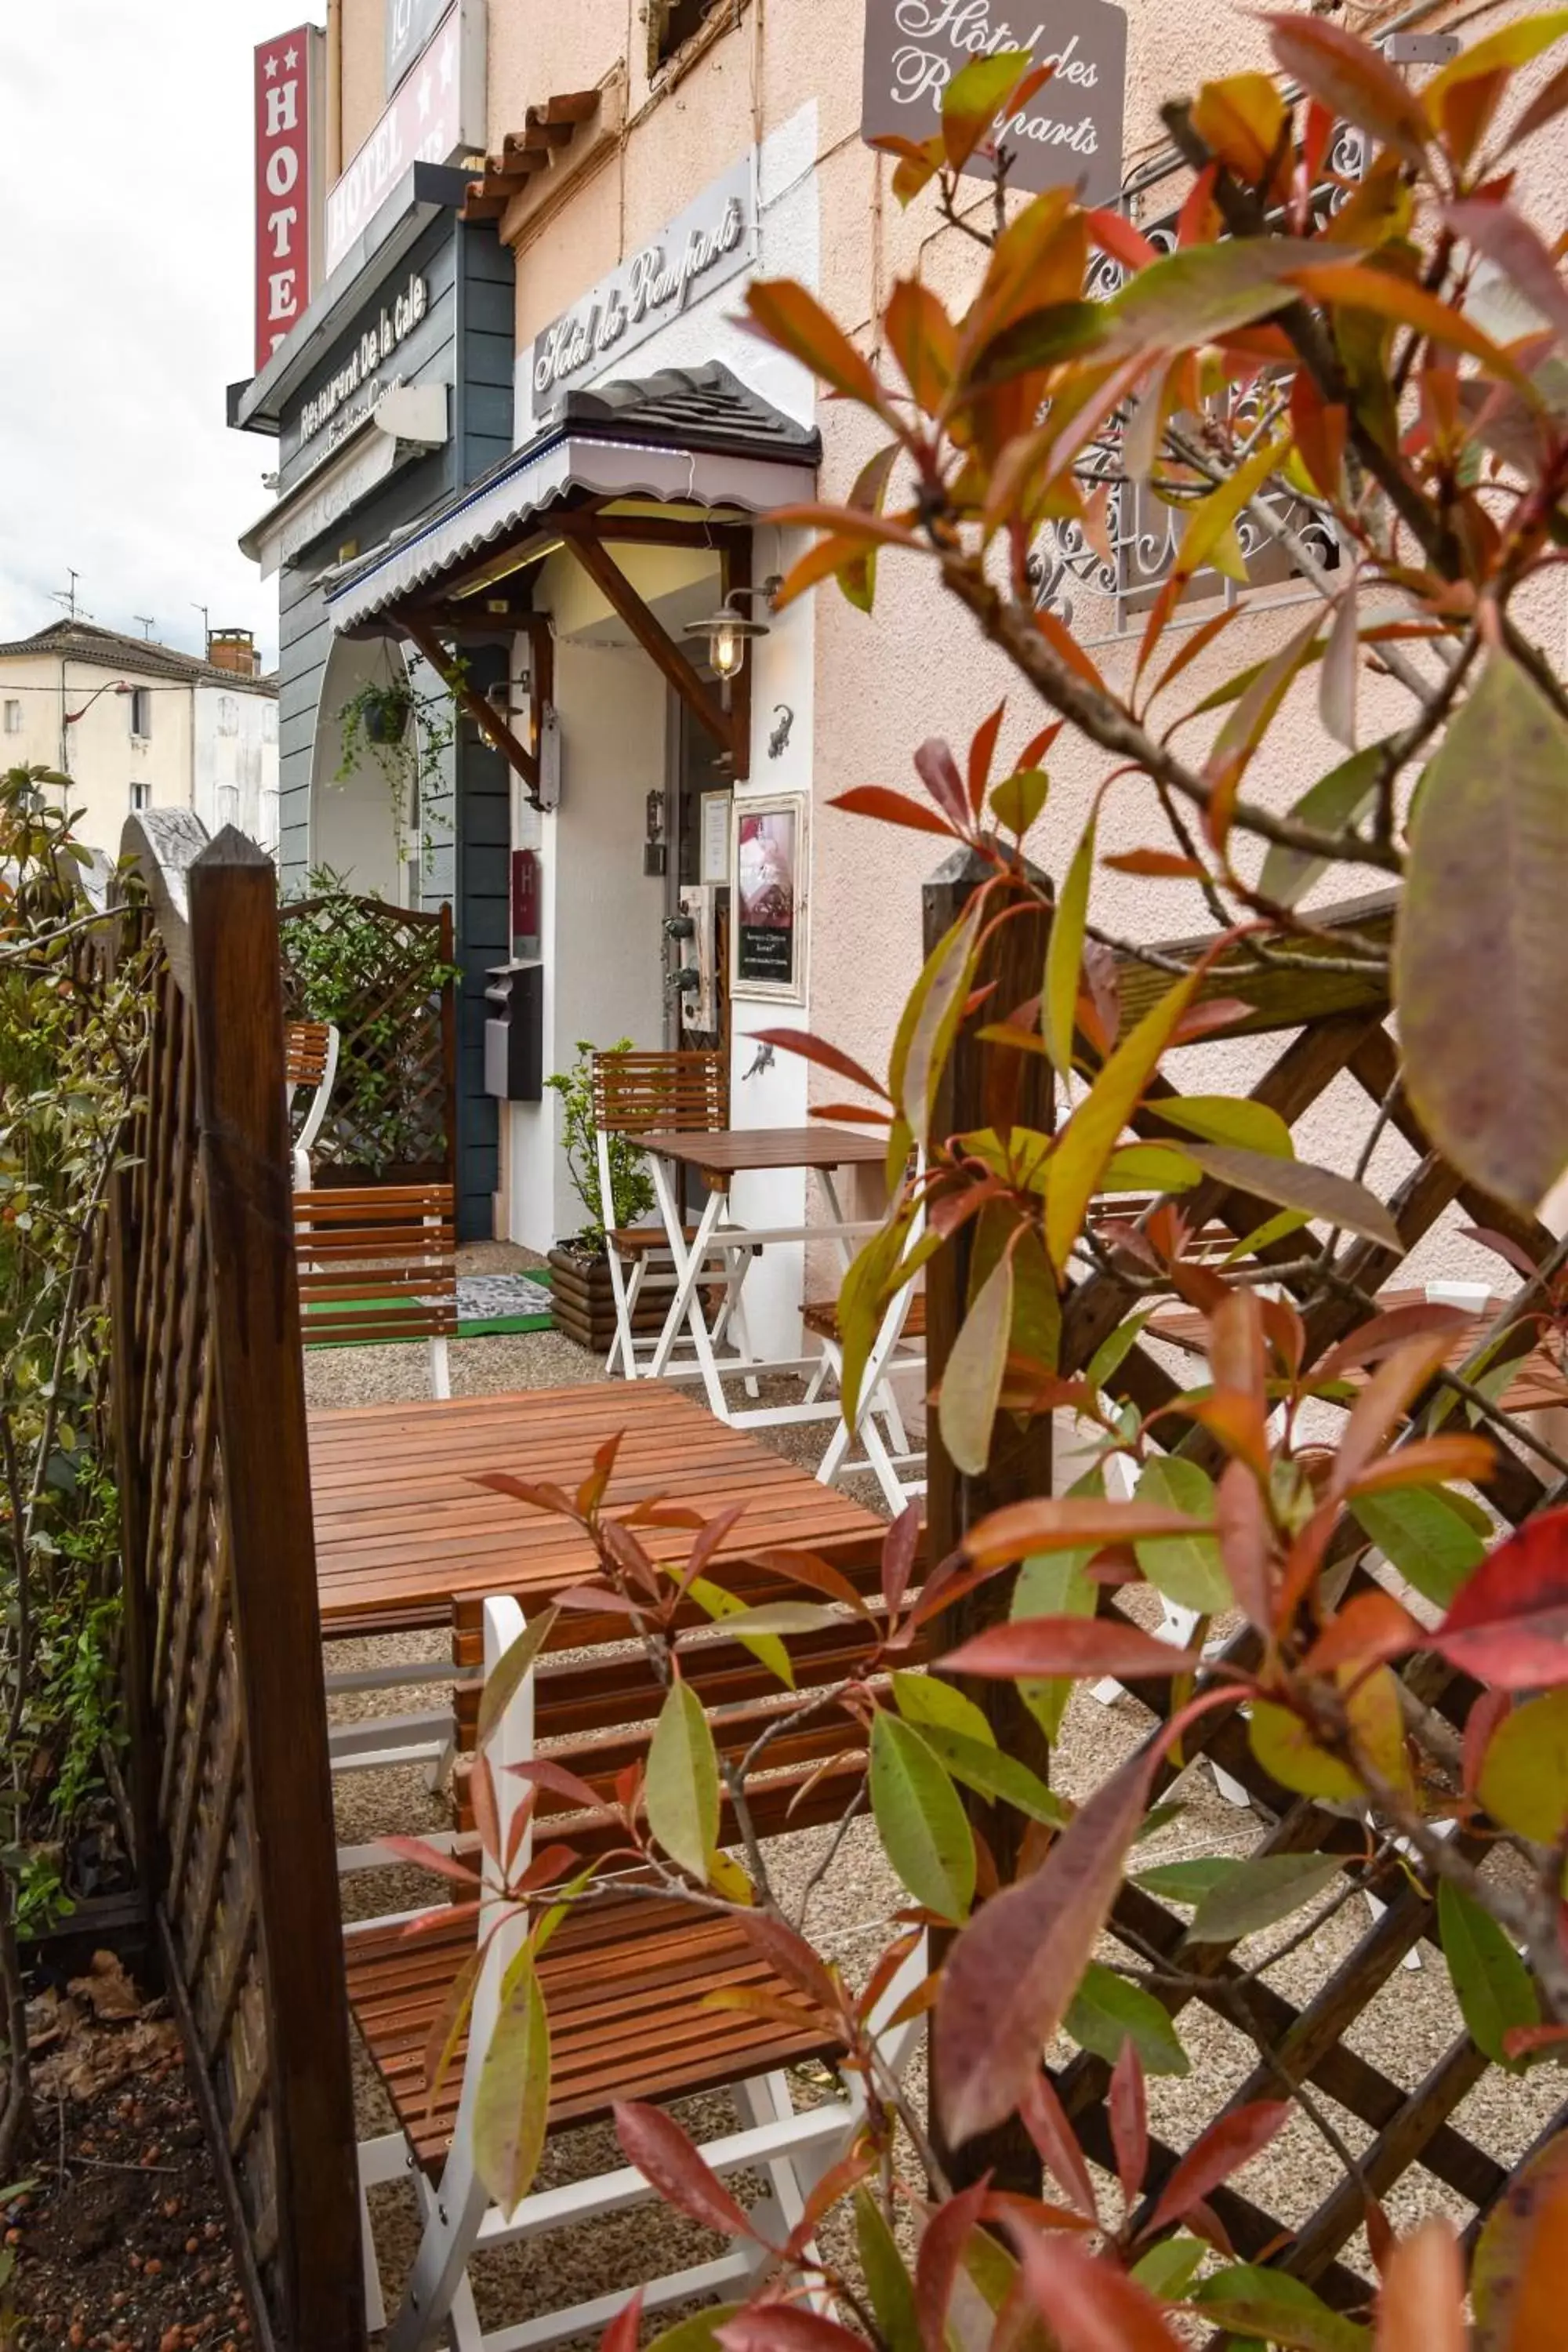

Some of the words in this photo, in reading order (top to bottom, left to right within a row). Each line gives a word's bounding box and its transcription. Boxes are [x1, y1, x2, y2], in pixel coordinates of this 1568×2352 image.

[891, 45, 1098, 154] Rparts
[1042, 35, 1098, 88] des
[331, 107, 403, 253] HOTEL
[300, 350, 361, 445] Restaurant
[361, 331, 380, 379] De
[381, 307, 394, 357] la
[395, 273, 428, 339] Cale
[594, 289, 628, 351] des
